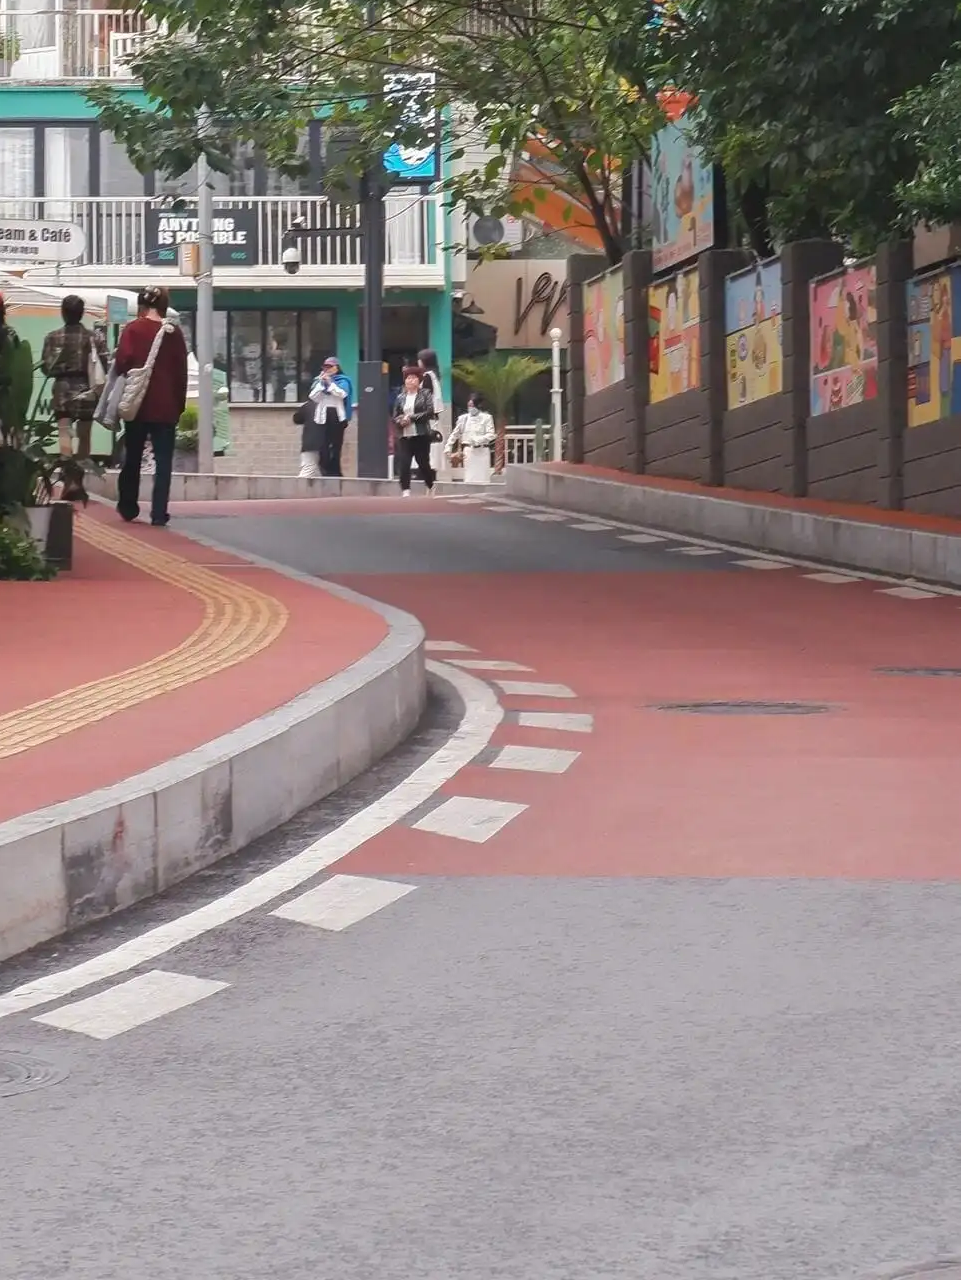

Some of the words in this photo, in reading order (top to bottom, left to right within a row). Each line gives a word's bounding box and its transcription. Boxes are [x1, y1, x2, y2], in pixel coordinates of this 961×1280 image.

[158, 217, 235, 231] ANYTNG
[28, 229, 38, 241] &
[41, 227, 72, 243] Café
[158, 231, 173, 245] IS
[175, 231, 247, 245] POIBLE
